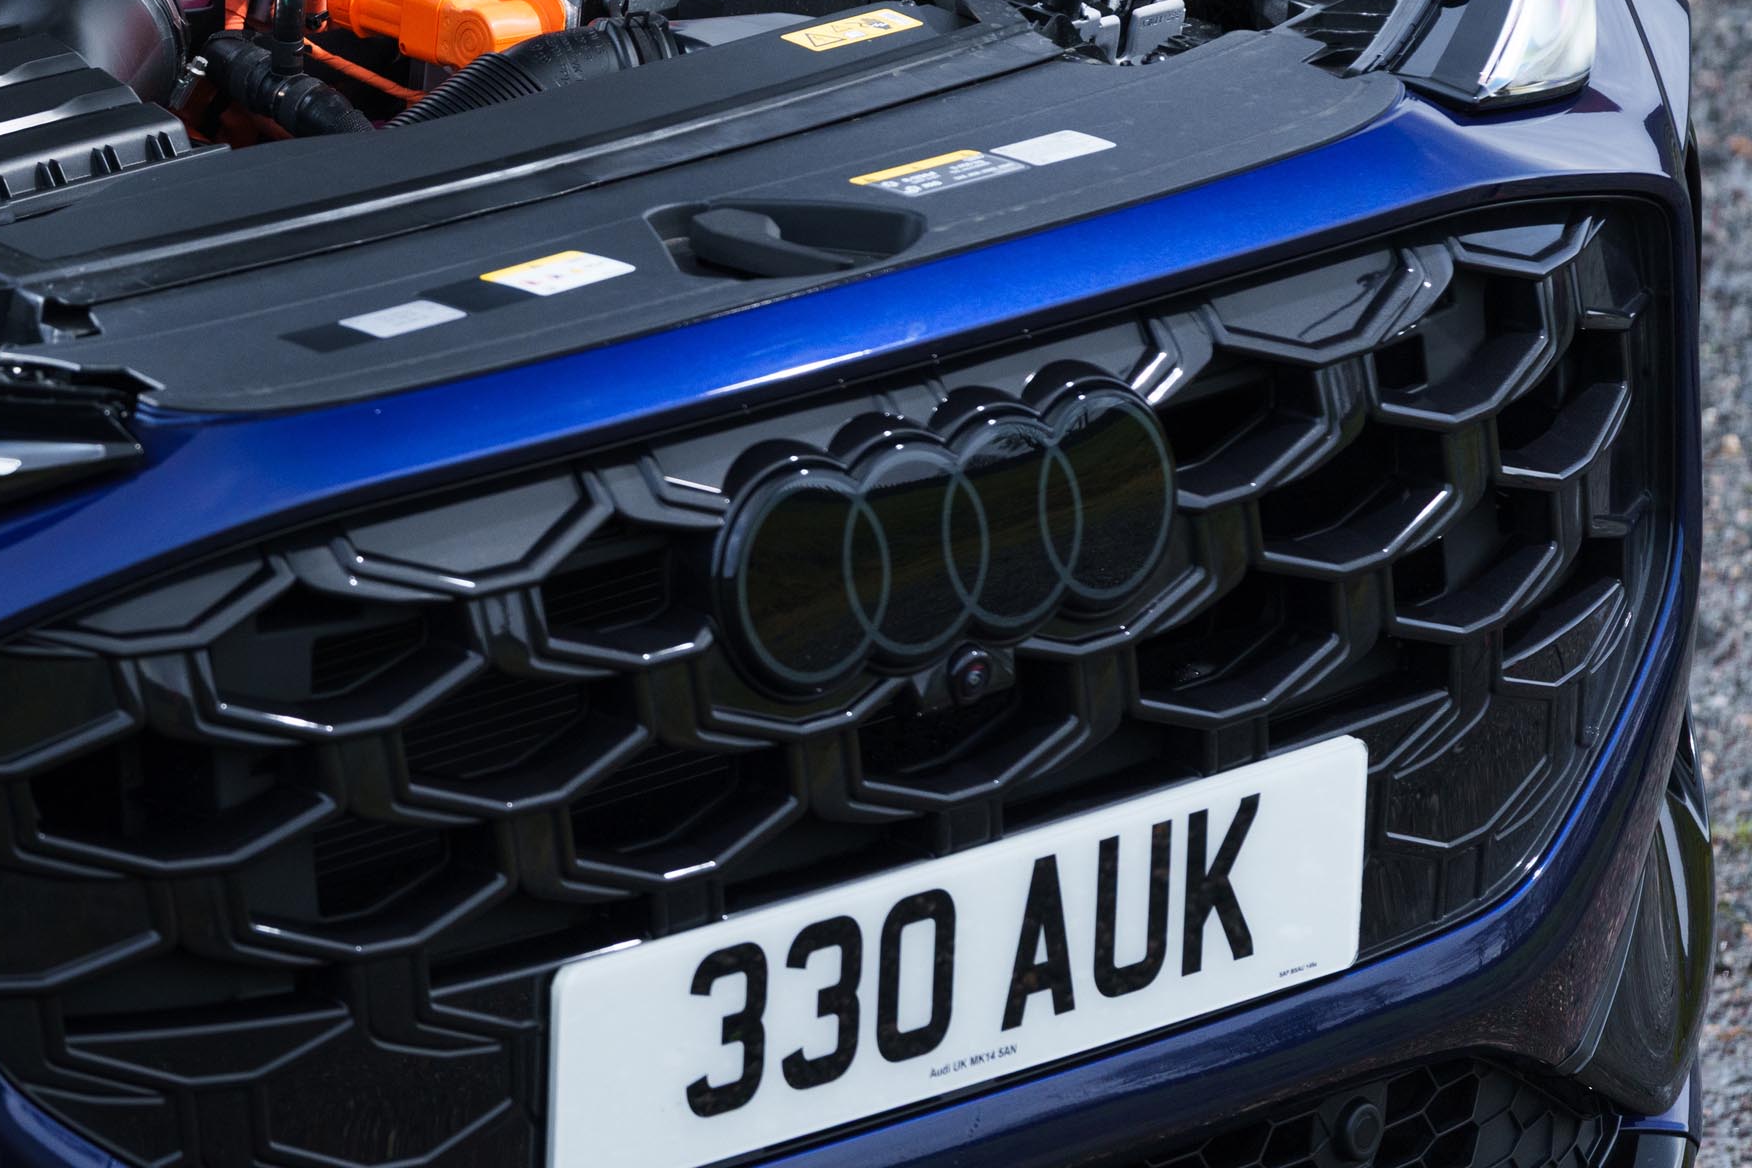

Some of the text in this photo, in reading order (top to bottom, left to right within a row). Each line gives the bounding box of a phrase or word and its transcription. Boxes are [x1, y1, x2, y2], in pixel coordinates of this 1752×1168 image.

[687, 793, 1260, 1117] 330 AUK
[929, 1064, 950, 1078] Audi
[953, 1059, 967, 1072] UK
[969, 1050, 996, 1067] MK14
